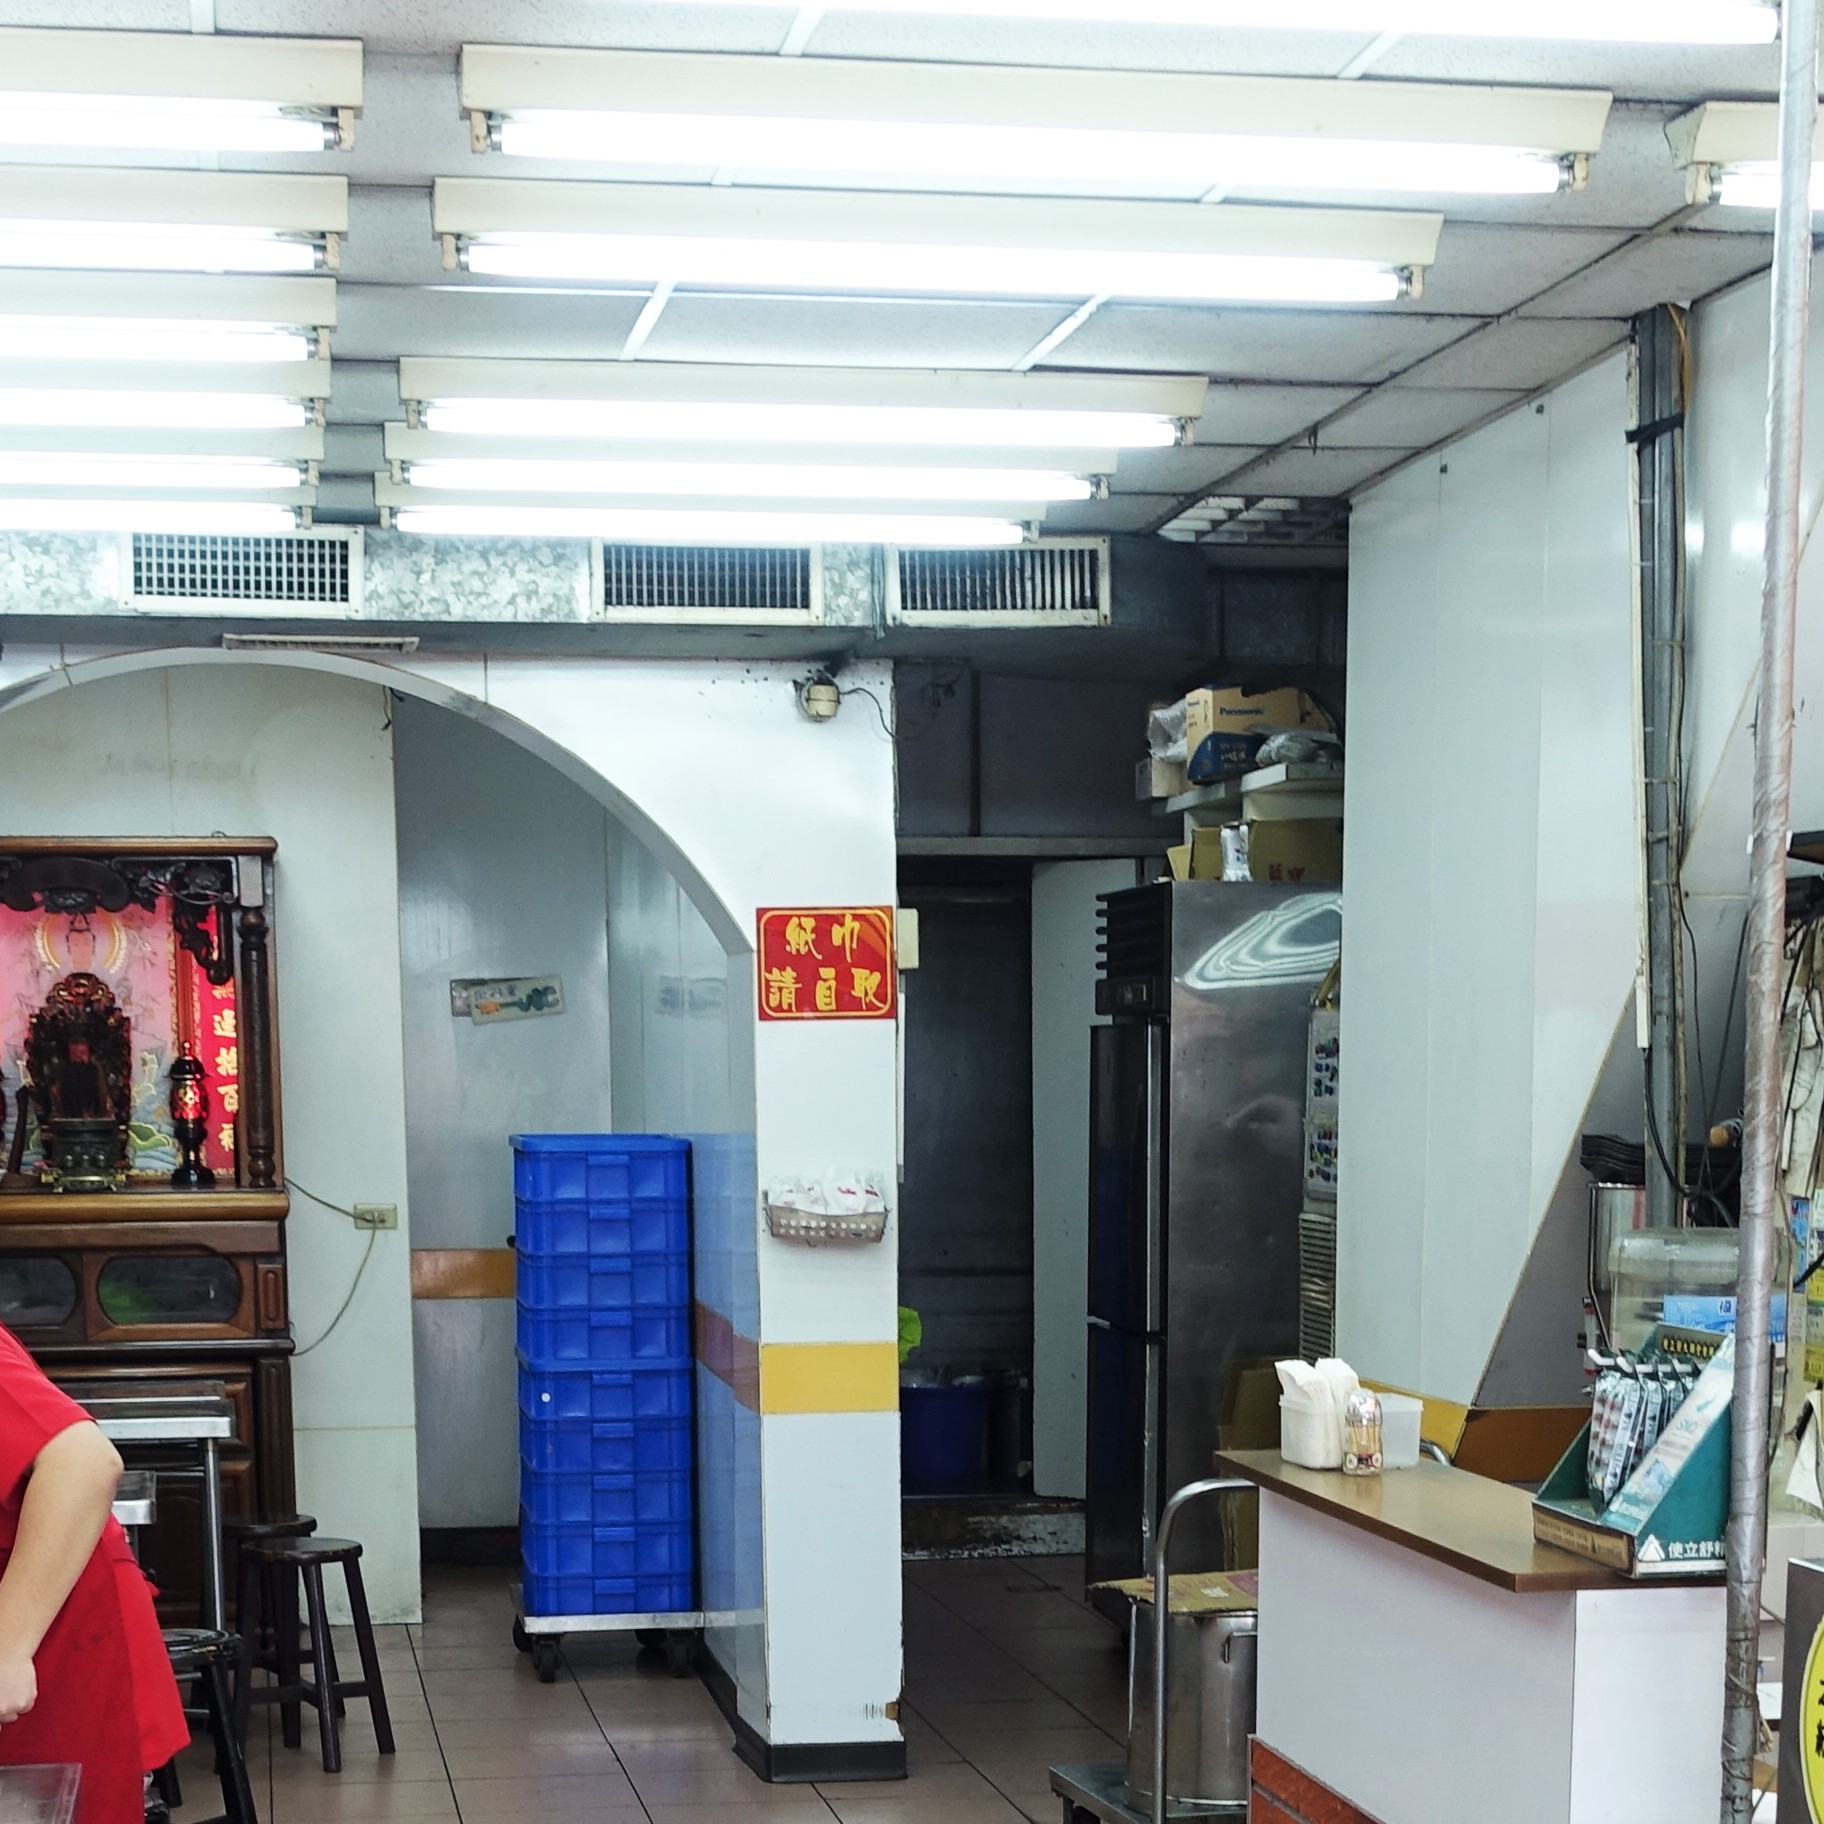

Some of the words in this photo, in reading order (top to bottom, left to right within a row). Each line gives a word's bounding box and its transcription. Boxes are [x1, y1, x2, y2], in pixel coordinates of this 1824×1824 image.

[785, 913, 861, 962] 紙巾
[764, 965, 886, 1013] 請自取
